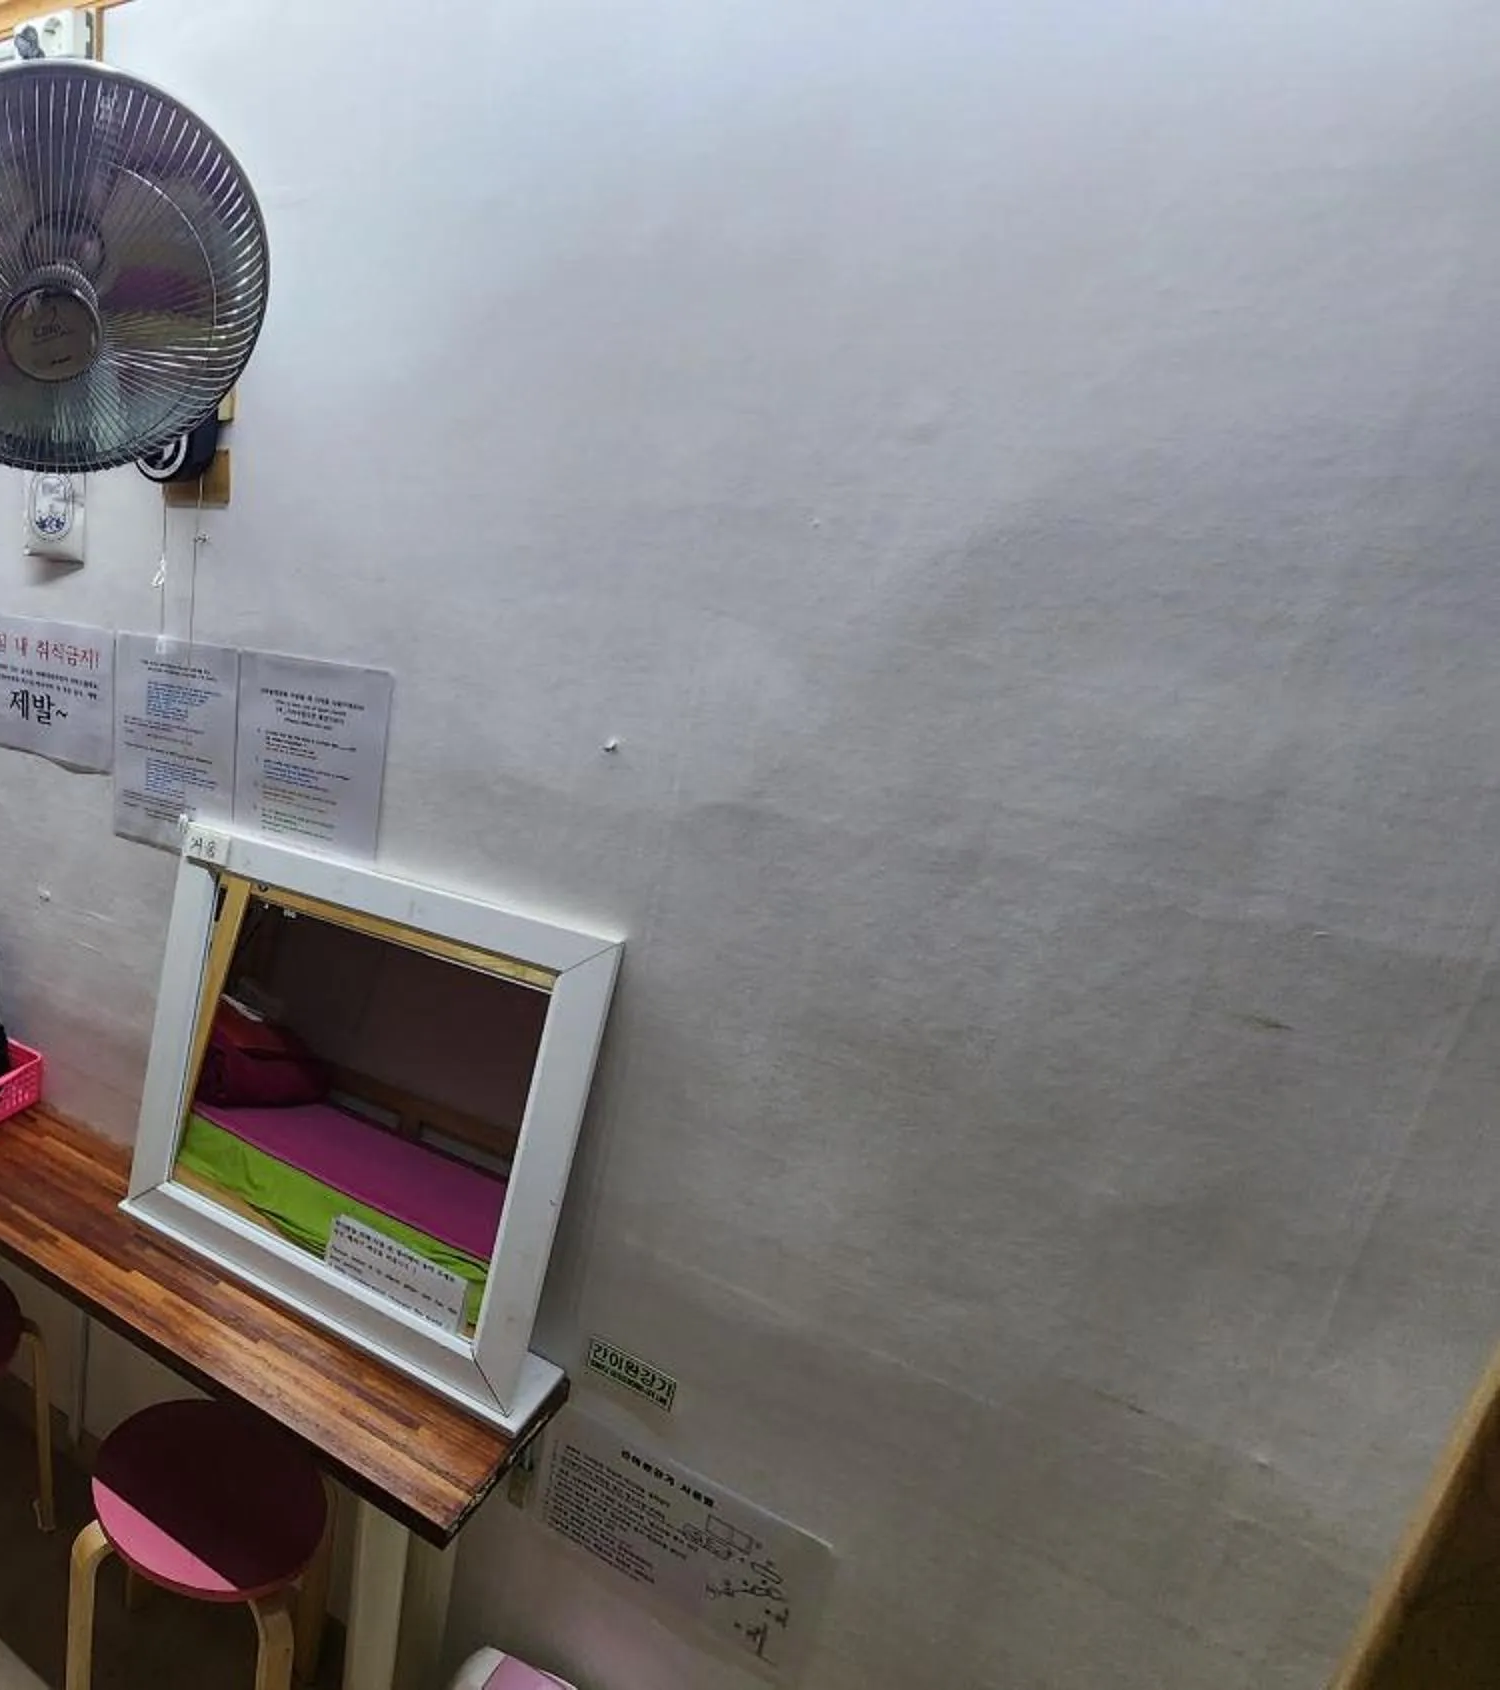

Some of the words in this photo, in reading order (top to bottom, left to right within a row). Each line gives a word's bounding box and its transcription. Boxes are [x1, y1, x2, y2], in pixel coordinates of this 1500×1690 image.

[14, 636, 29, 657] 내
[9, 689, 68, 726] 제발~
[592, 1342, 673, 1397] 간이완강기
